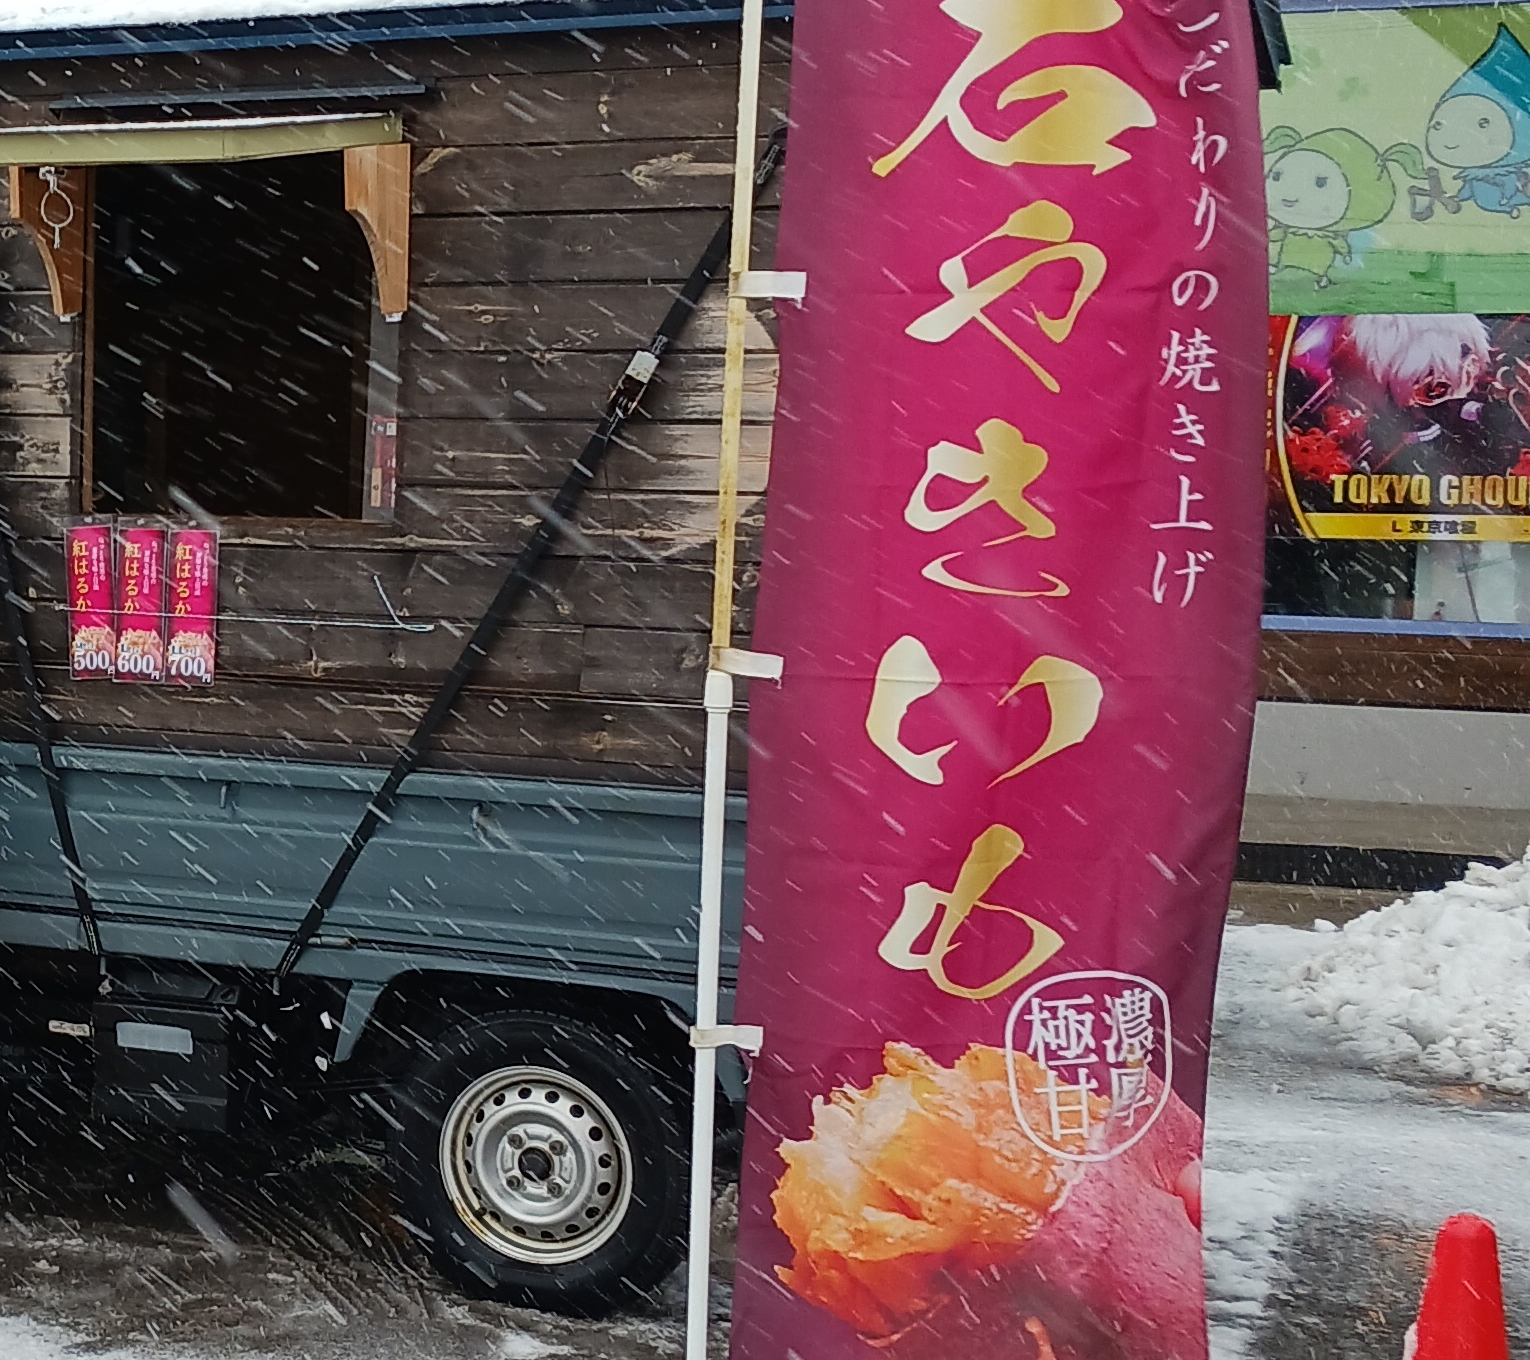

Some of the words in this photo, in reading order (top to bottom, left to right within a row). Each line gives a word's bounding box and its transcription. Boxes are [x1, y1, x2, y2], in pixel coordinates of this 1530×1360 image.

[1329, 474, 1431, 507] TOKYO
[1439, 474, 1530, 508] GHOU
[72, 539, 92, 611] 紅はるか
[124, 541, 141, 614] 紅はるか
[174, 542, 192, 615] 紅はるか
[1023, 993, 1099, 1143] 極甘
[1101, 987, 1155, 1129] 濃厚
